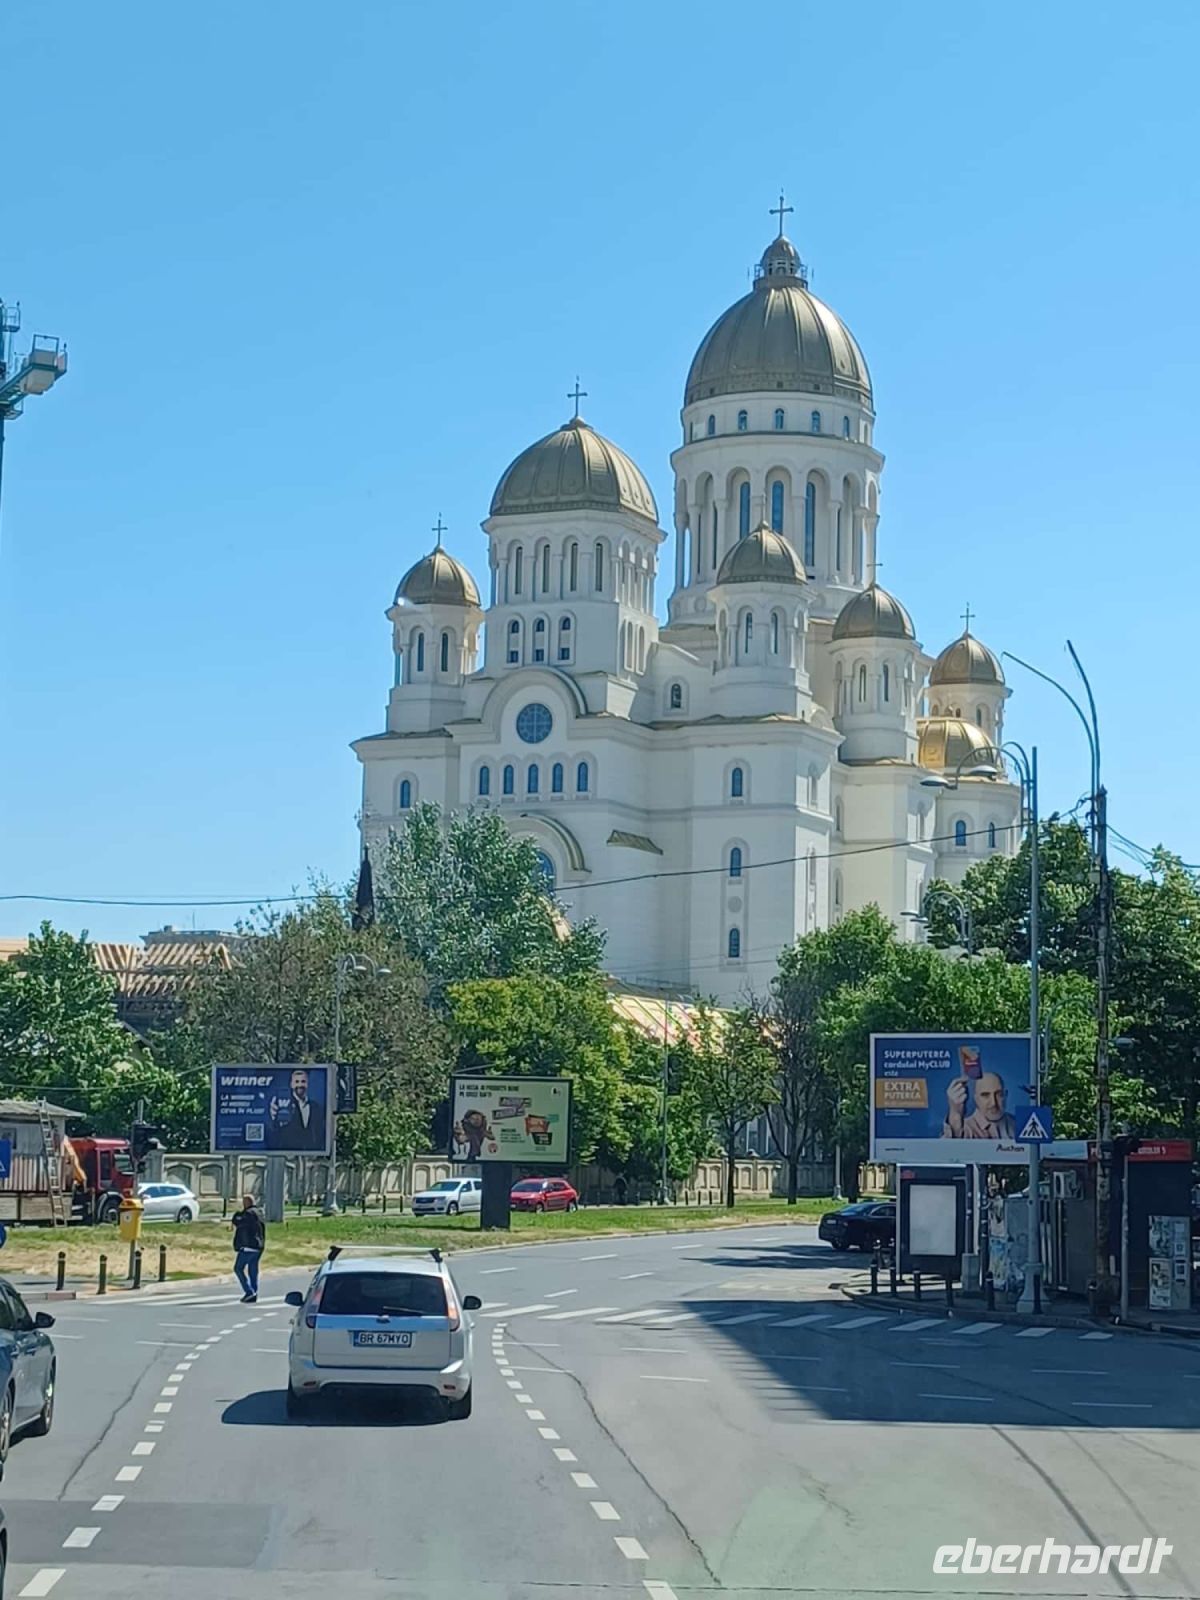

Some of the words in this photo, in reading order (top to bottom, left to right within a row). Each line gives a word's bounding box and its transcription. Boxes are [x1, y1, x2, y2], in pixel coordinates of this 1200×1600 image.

[884, 1050, 951, 1059] SUPERPUTEREA
[918, 1060, 951, 1070] MyCLUB
[220, 1075, 273, 1086] winner
[884, 1081, 921, 1091] EXTRA
[996, 1144, 1025, 1152] Auchan
[360, 1333, 374, 1344] BR
